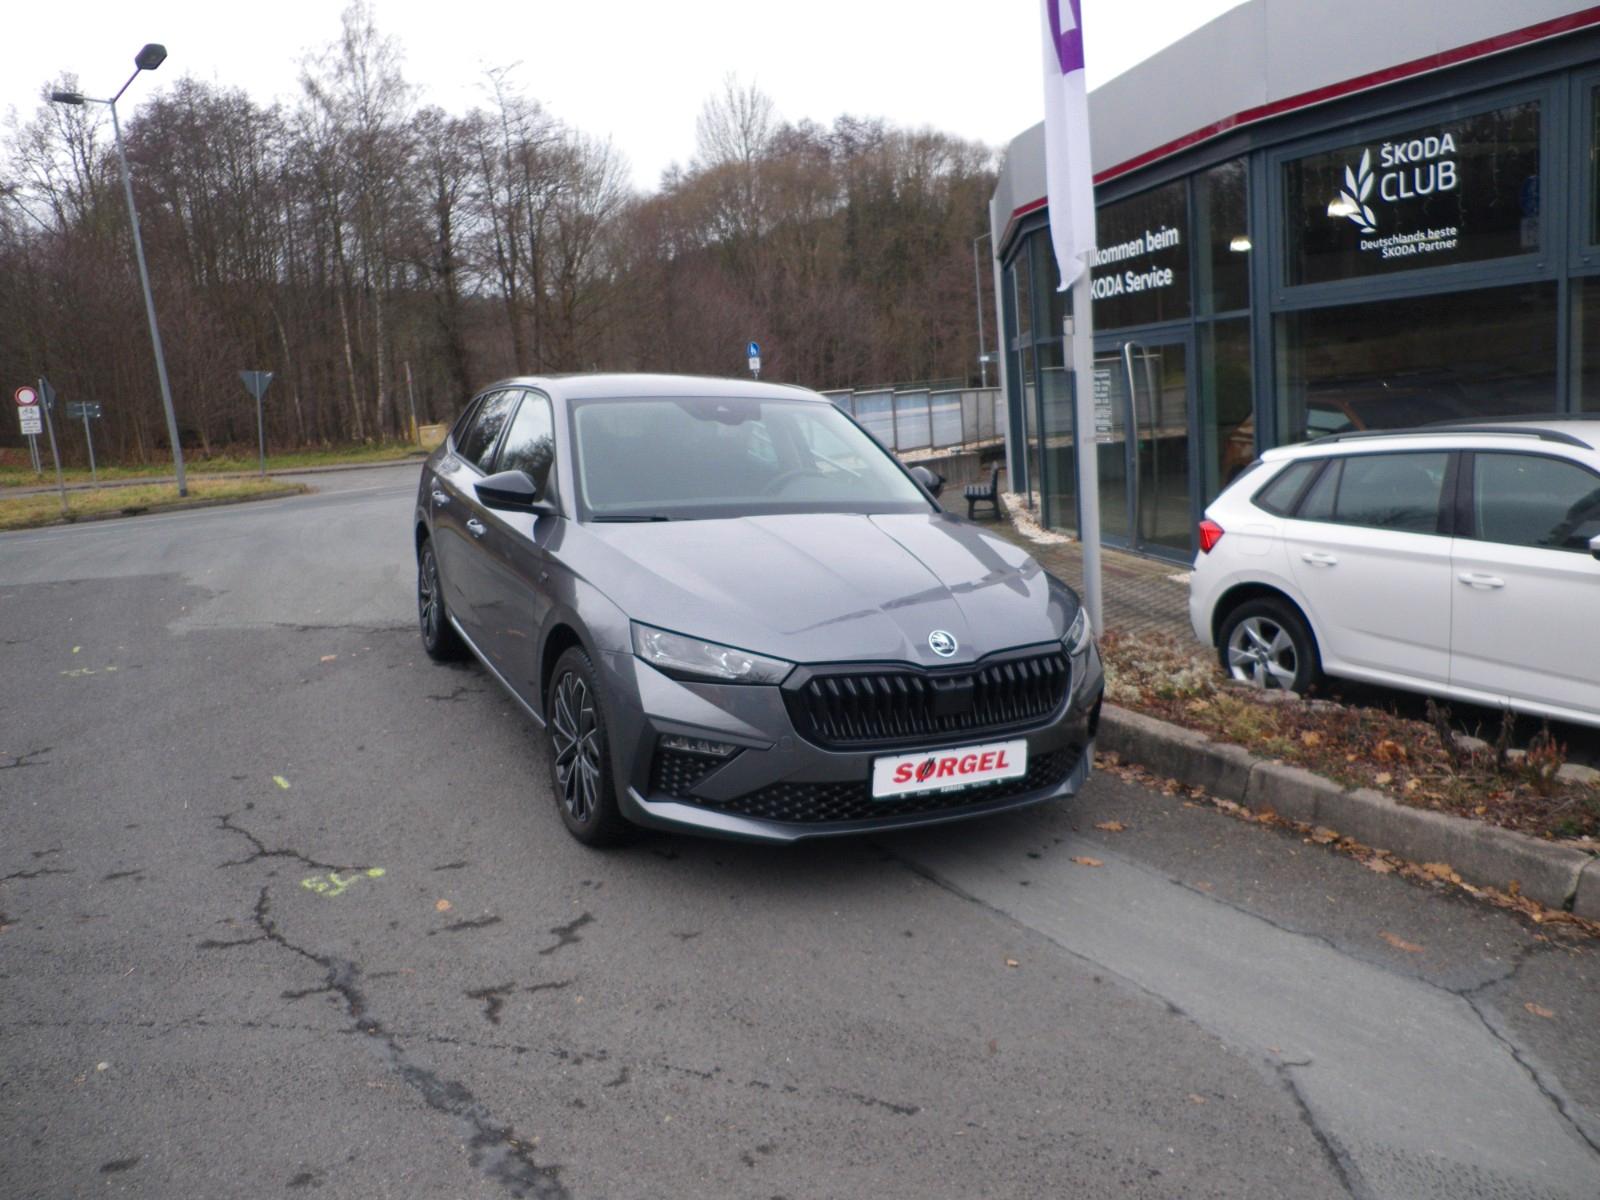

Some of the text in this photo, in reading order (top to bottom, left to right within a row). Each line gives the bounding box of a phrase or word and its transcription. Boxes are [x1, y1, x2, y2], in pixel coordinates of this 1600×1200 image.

[1381, 133, 1456, 168] ŠKODA
[1381, 161, 1457, 201] CLUB
[1146, 226, 1179, 252] beim
[1361, 227, 1457, 250] Deutschlands beste
[1382, 240, 1457, 259] ŠKODA Partner
[1126, 265, 1173, 293] Service
